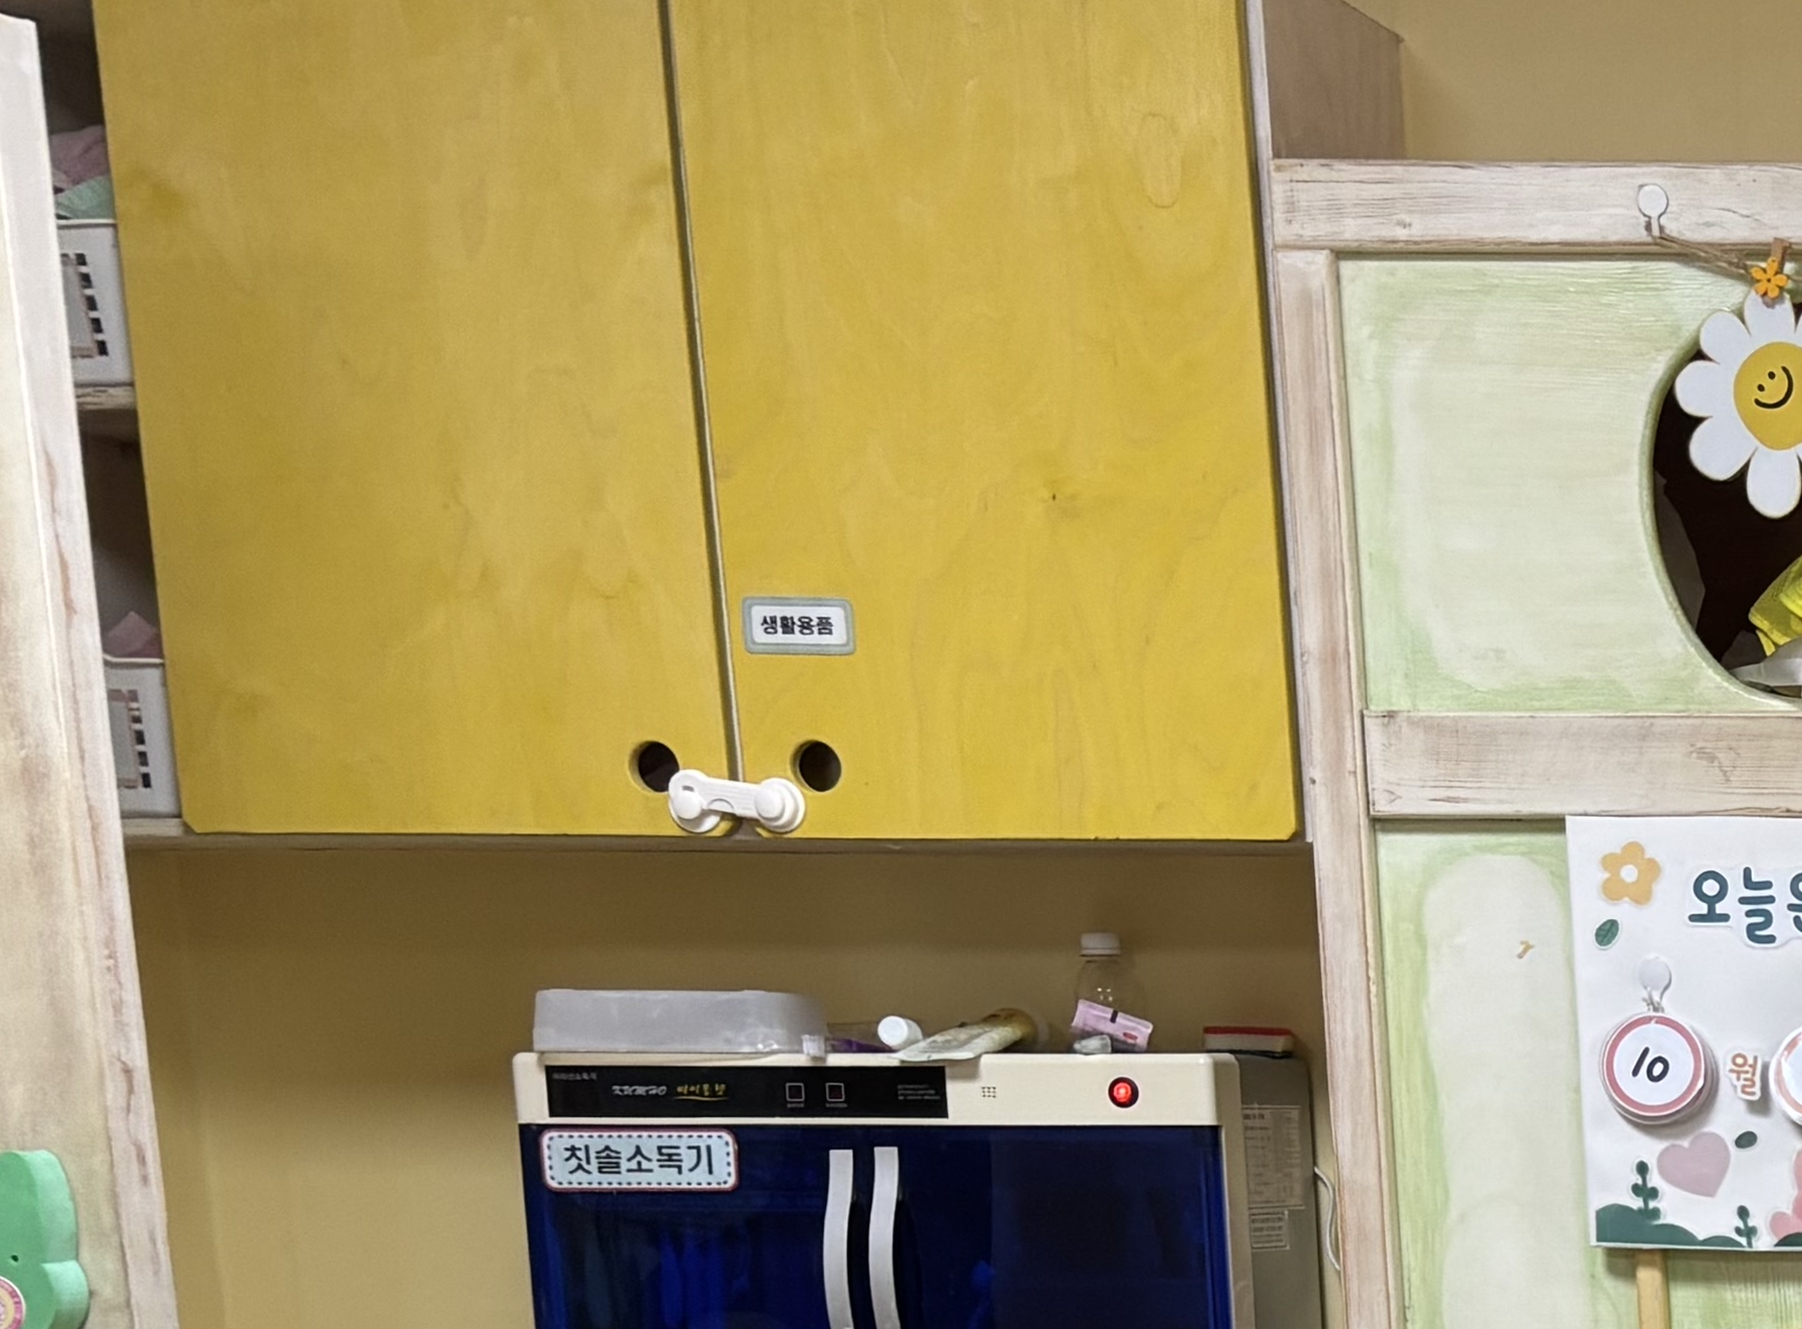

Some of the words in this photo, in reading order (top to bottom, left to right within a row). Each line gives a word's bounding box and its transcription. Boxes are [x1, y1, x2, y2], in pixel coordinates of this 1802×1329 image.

[761, 615, 834, 635] 생활용품
[1632, 1046, 1670, 1084] 10
[1728, 1052, 1758, 1097] 월
[563, 1143, 714, 1175] 칫솔소독기
